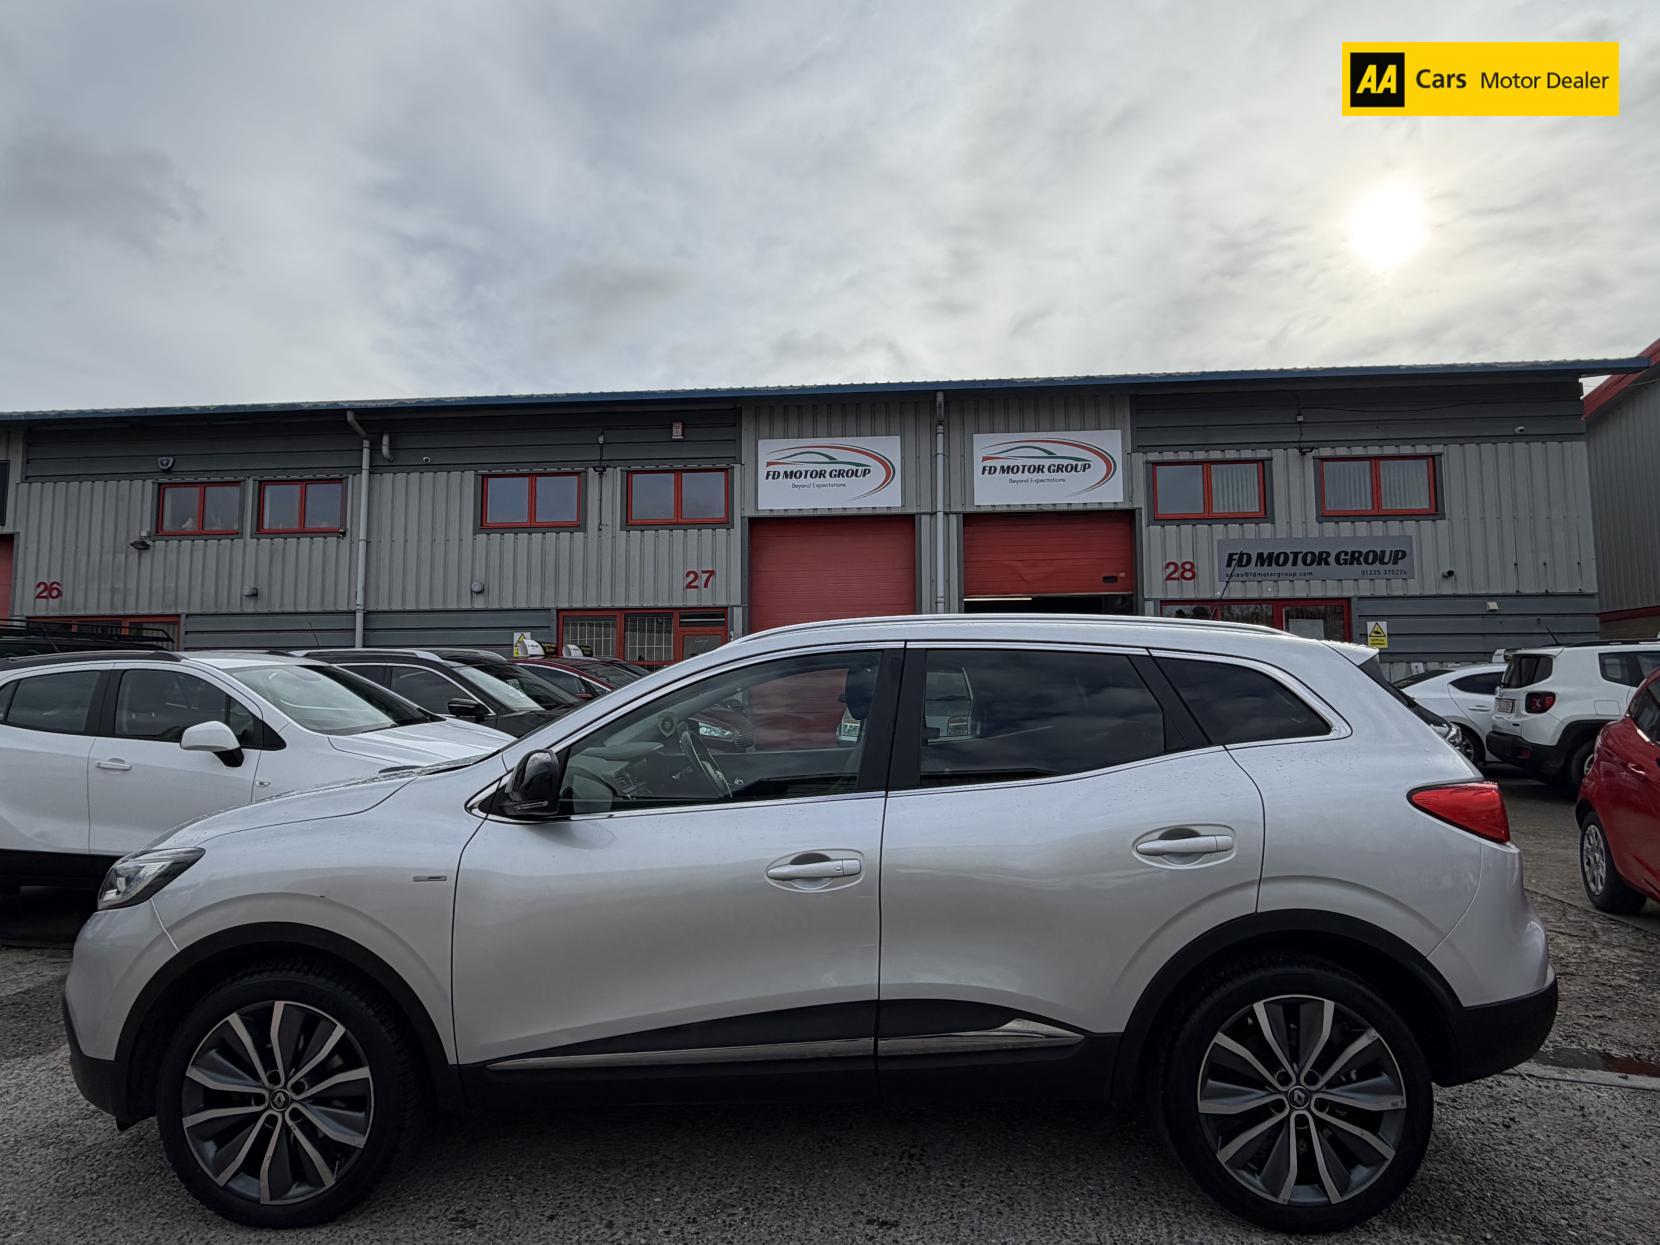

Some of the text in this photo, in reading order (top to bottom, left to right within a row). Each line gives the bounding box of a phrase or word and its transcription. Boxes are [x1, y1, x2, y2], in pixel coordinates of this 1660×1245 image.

[765, 468, 871, 480] FD MOTOR GROUP
[981, 463, 1091, 475] FD MOTOR GROUP
[1225, 549, 1408, 568] FD MOTOR GROUP
[685, 569, 716, 590] 27
[1164, 560, 1196, 581] 28
[34, 581, 63, 600] 26
